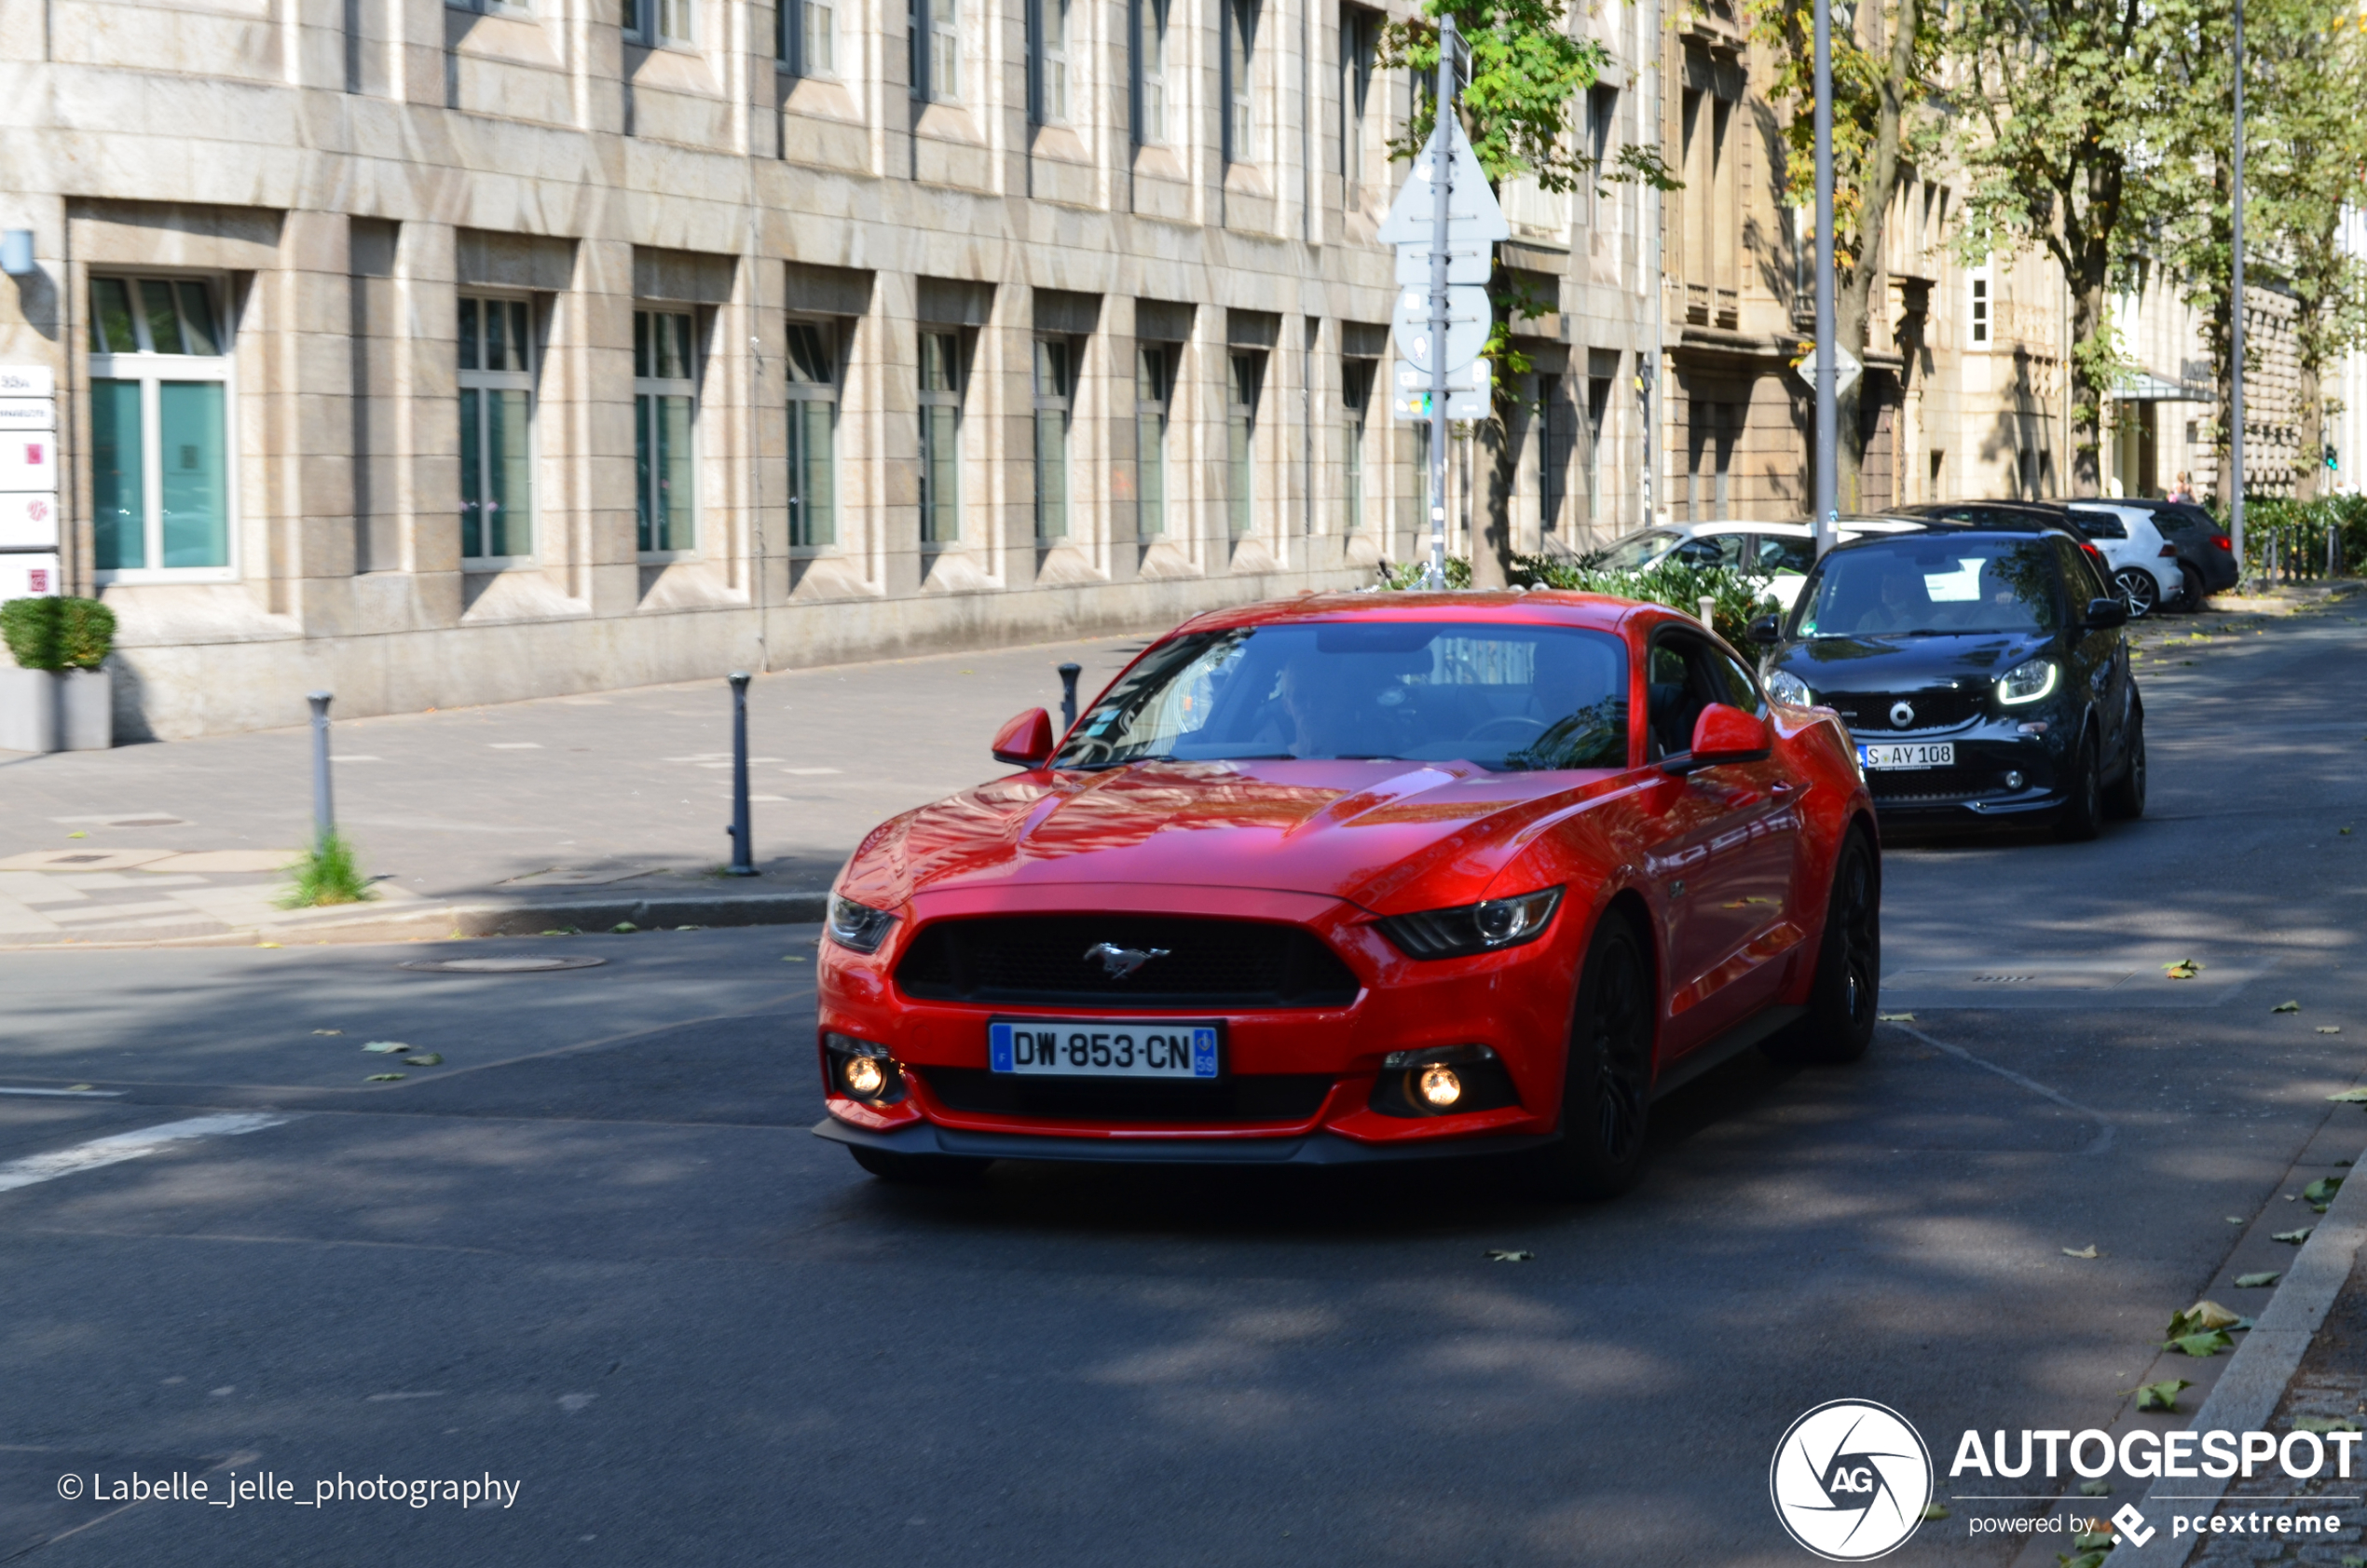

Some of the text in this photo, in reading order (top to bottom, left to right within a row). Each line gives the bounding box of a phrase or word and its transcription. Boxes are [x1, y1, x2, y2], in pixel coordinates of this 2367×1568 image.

[1868, 746, 1950, 764] S AY 108
[1014, 1031, 1191, 1070] DW-853-CN
[1197, 1056, 1215, 1073] 59
